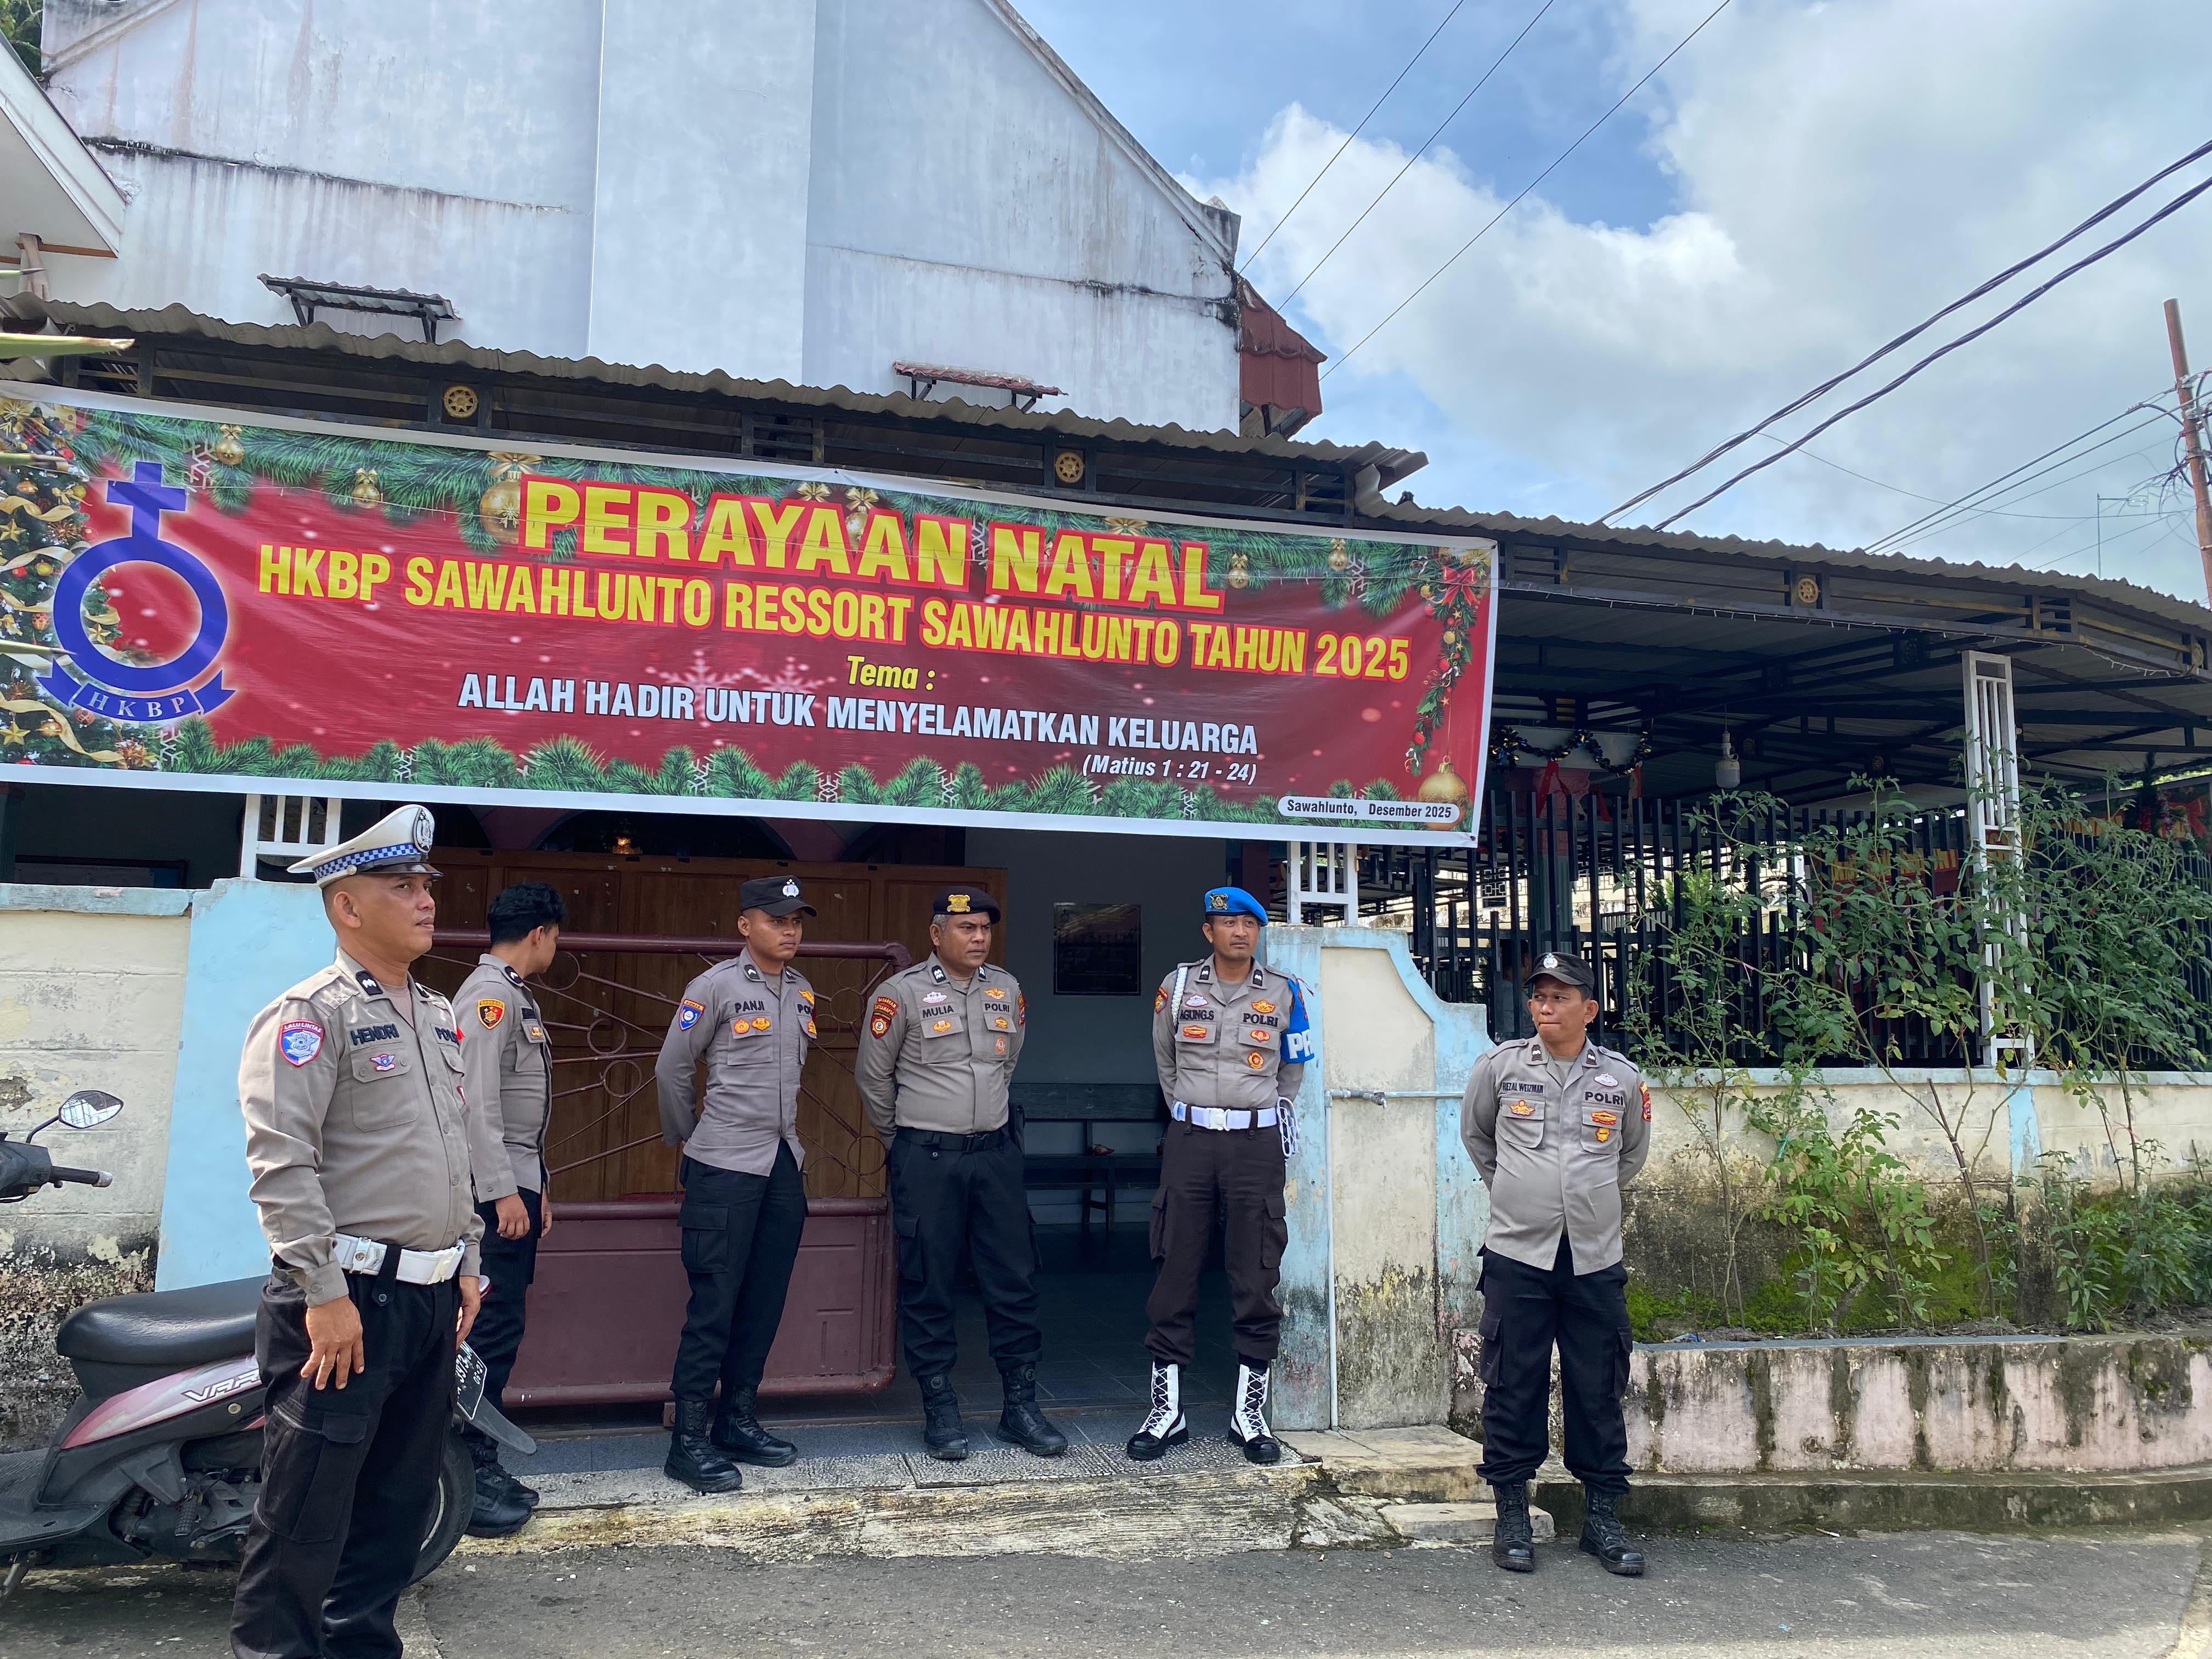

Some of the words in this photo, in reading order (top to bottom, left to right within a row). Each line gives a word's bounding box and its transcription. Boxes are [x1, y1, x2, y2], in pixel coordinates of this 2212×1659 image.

[524, 481, 966, 585] PERAYAAN
[992, 527, 1221, 610] NATAL
[258, 544, 391, 601] HKBP
[405, 557, 711, 627] SAWAHLUNTO
[726, 586, 913, 643] RESSORT
[922, 601, 1180, 664] SAWAHLUNTO
[1191, 624, 1306, 674] TAHUN
[1316, 634, 1409, 680] 2025
[847, 656, 918, 690] Tema
[926, 670, 936, 690] :
[88, 691, 185, 718] HKBP
[458, 674, 574, 713] ALLAH
[585, 682, 695, 720] HADIR
[706, 689, 815, 727] UNTUK
[826, 697, 1099, 746] MENYELAMATKAN
[1108, 717, 1258, 755] KELUARGA
[1082, 755, 1155, 777] (Matius
[1161, 760, 1171, 777] 1
[1187, 761, 1210, 779] 21
[1226, 763, 1257, 785] 24)
[1287, 799, 1358, 816] Sawahlunto,
[1369, 804, 1423, 818] Desember
[1425, 806, 1452, 819] 2025
[735, 1000, 765, 1014] PANJI
[923, 1005, 954, 1018] MULIA
[985, 1003, 1009, 1013] POLRI
[301, 1022, 322, 1033] LINTAS
[1243, 1013, 1279, 1028] POLRI
[350, 1024, 400, 1046] HENDRI
[1503, 1082, 1517, 1091] REZAL
[1585, 1091, 1623, 1105] POLRI
